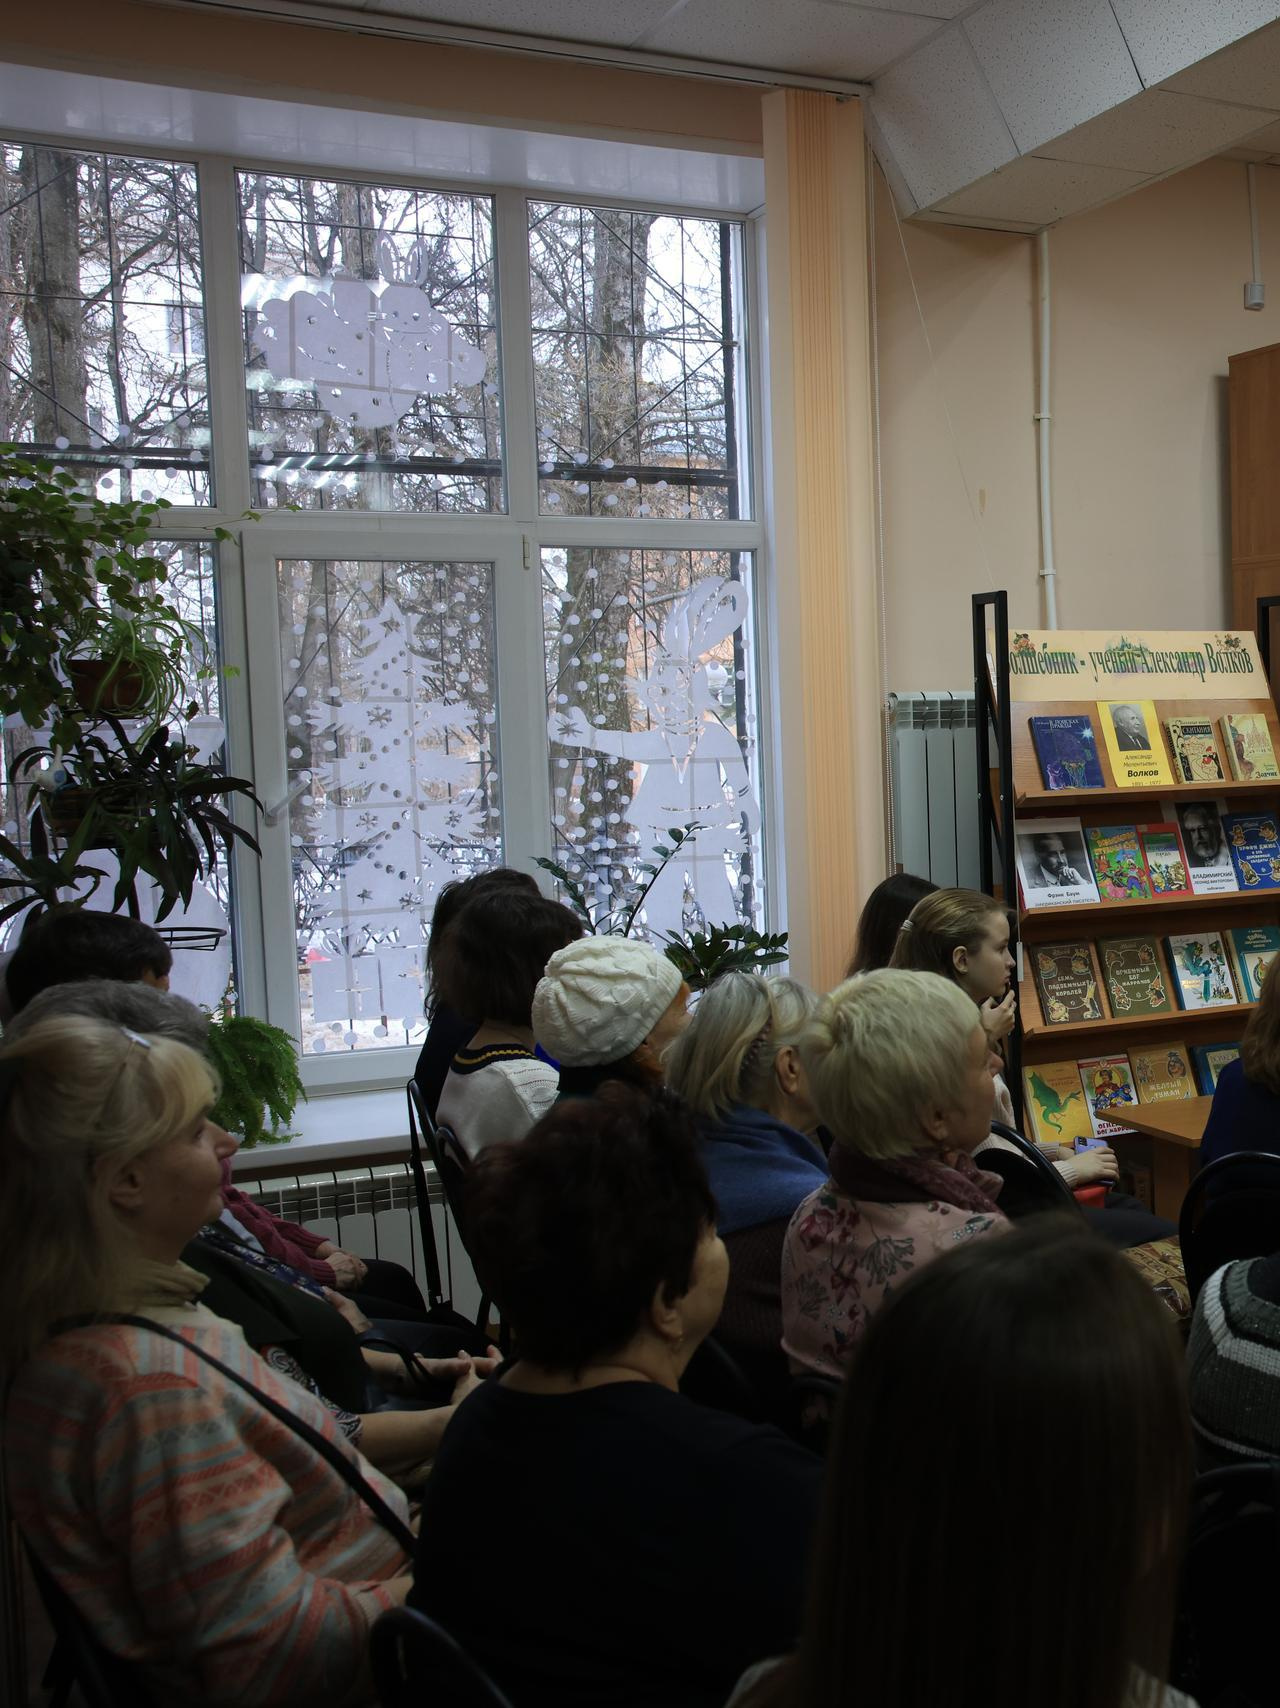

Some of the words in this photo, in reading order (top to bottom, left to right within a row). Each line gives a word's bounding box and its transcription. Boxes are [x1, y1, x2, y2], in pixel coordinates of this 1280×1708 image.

[1009, 643, 1079, 675] олшебник
[1140, 649, 1206, 682] Александр
[1204, 643, 1254, 674] Волков
[1127, 769, 1159, 778] Волков
[1192, 871, 1233, 879] ВЛАДИМИРСКИЙ
